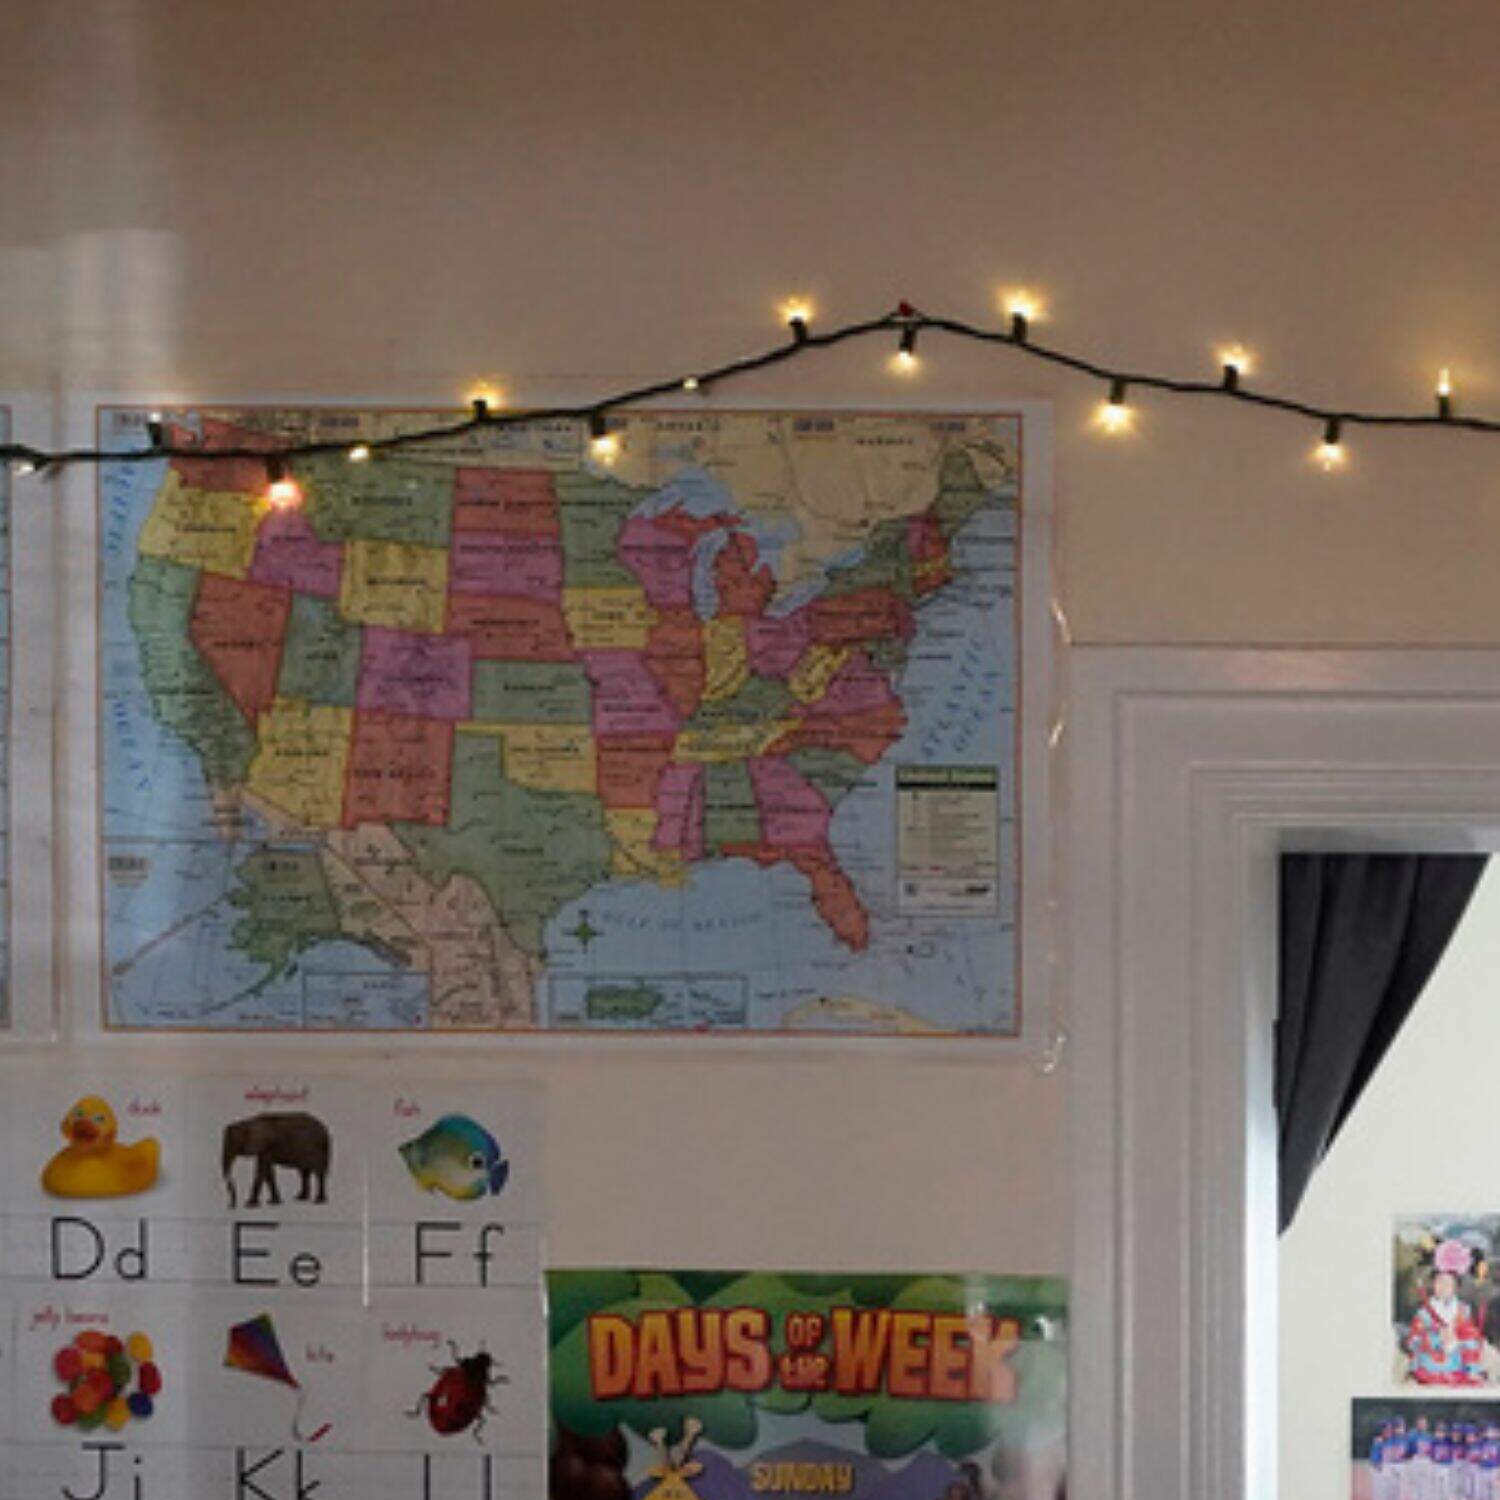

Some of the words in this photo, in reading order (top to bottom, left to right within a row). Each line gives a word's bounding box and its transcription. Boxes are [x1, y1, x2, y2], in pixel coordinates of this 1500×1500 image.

[587, 1305, 772, 1400] DAYS
[785, 1312, 823, 1348] OF
[829, 1306, 1019, 1403] WEEK
[752, 1460, 856, 1493] SUNDAY
